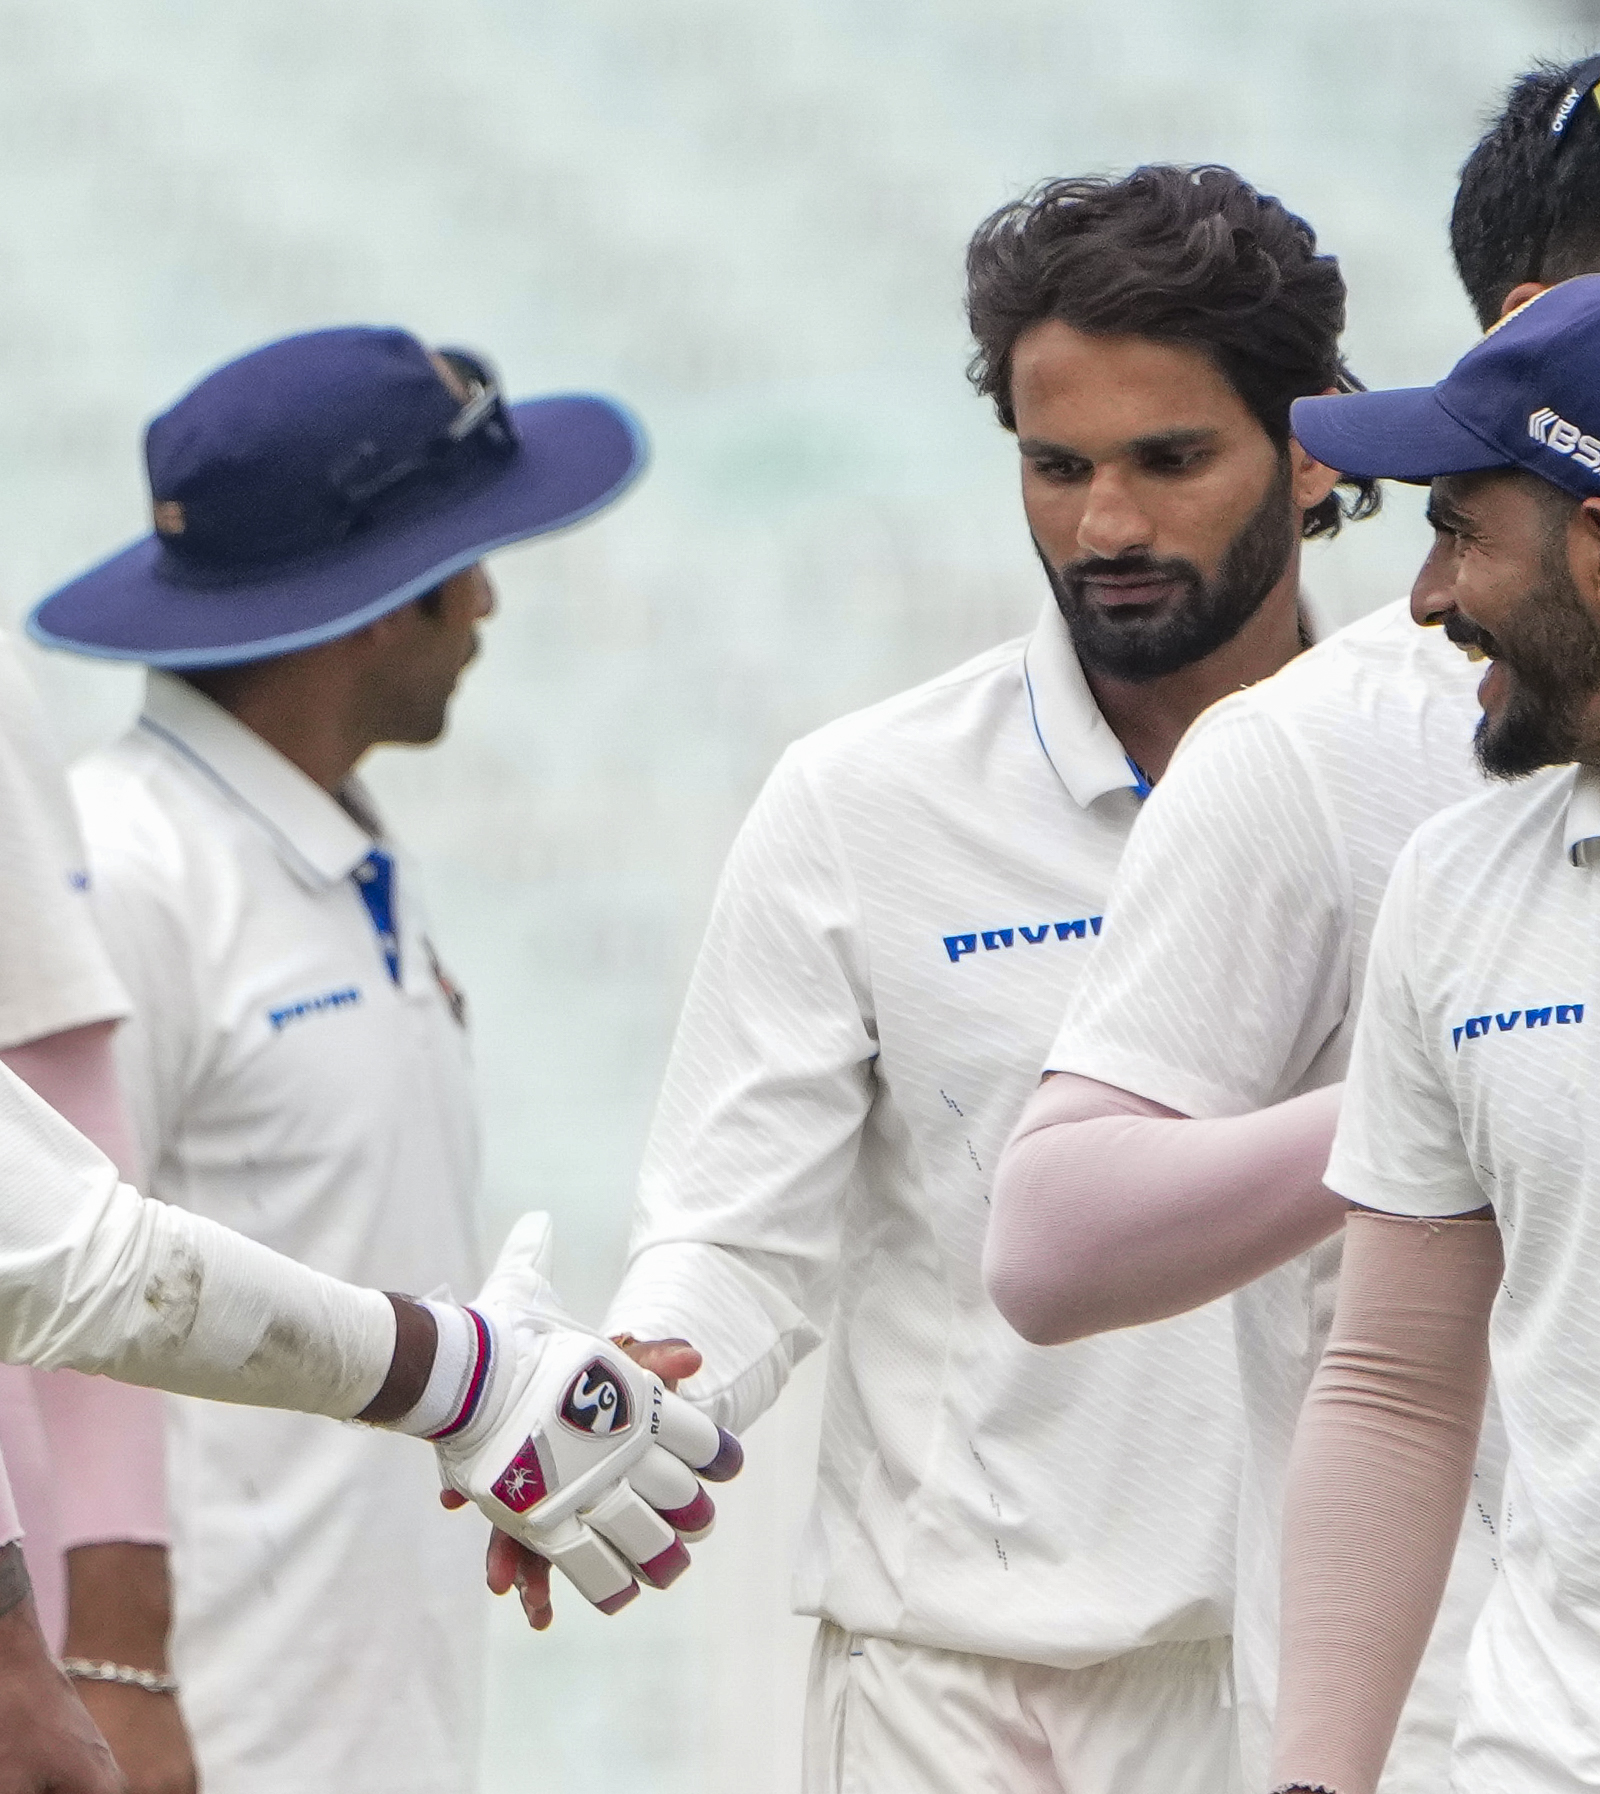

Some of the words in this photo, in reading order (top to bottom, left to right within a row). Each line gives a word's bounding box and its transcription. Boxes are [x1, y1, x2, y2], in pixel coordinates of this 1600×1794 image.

[1547, 418, 1600, 475] BS
[653, 1385, 663, 1406] 17
[650, 1411, 661, 1435] RP
